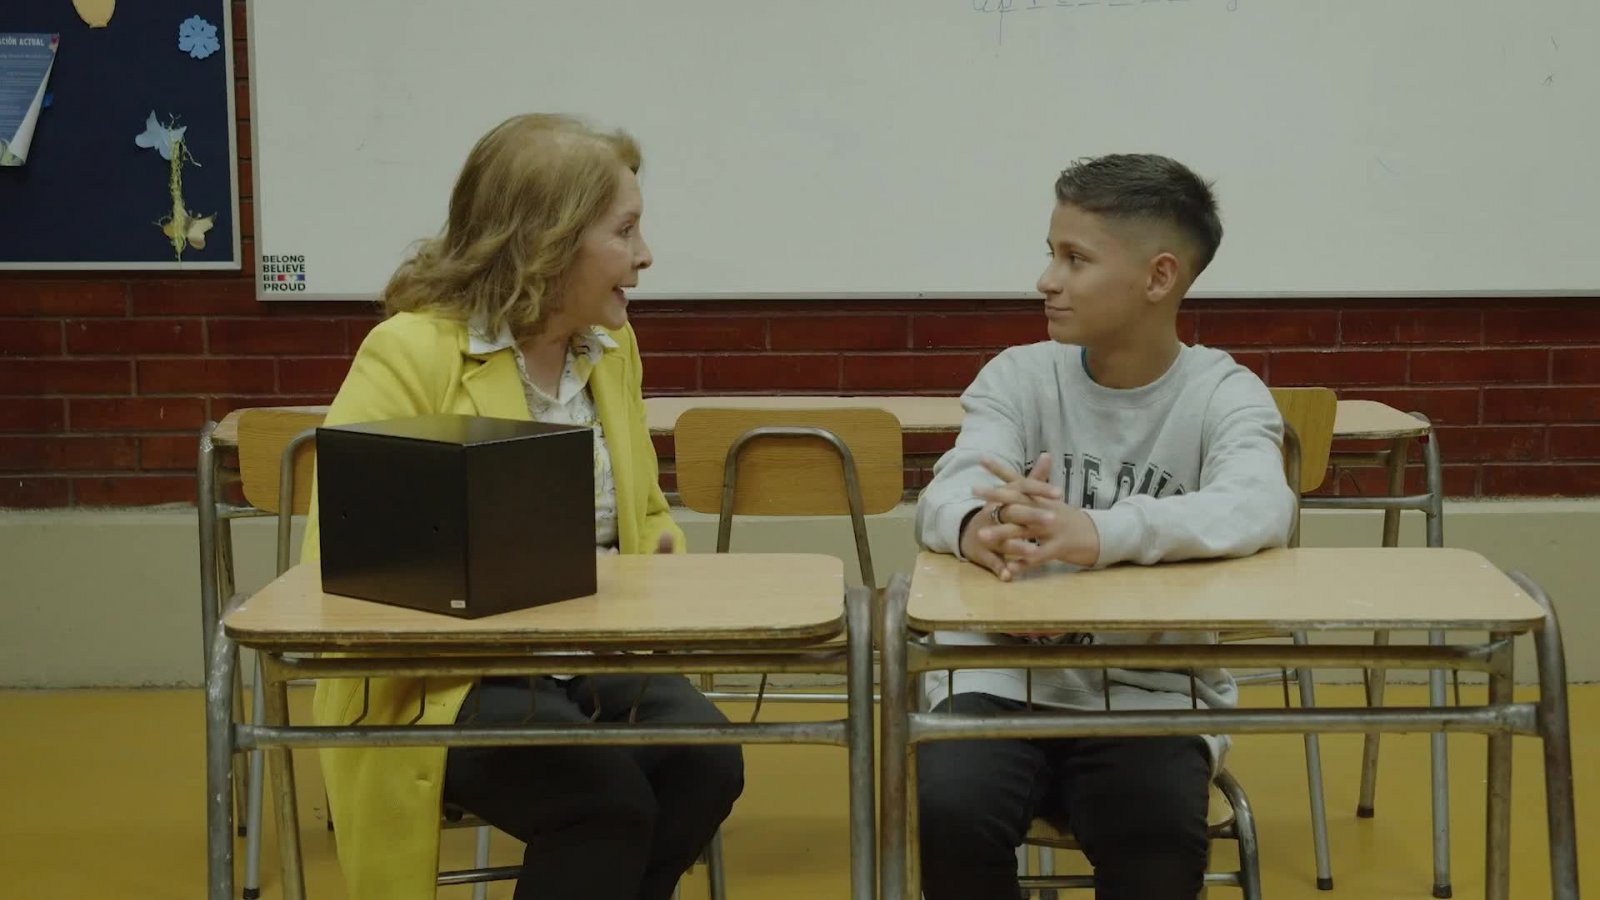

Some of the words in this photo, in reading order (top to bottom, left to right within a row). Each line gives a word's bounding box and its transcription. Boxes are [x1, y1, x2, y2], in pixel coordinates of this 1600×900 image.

[0, 36, 17, 46] CIÓN
[19, 37, 45, 47] ACTUAL
[262, 255, 305, 263] BELONG
[263, 264, 306, 273] BELIEVE
[263, 273, 277, 281] BE
[263, 282, 306, 292] PROUD
